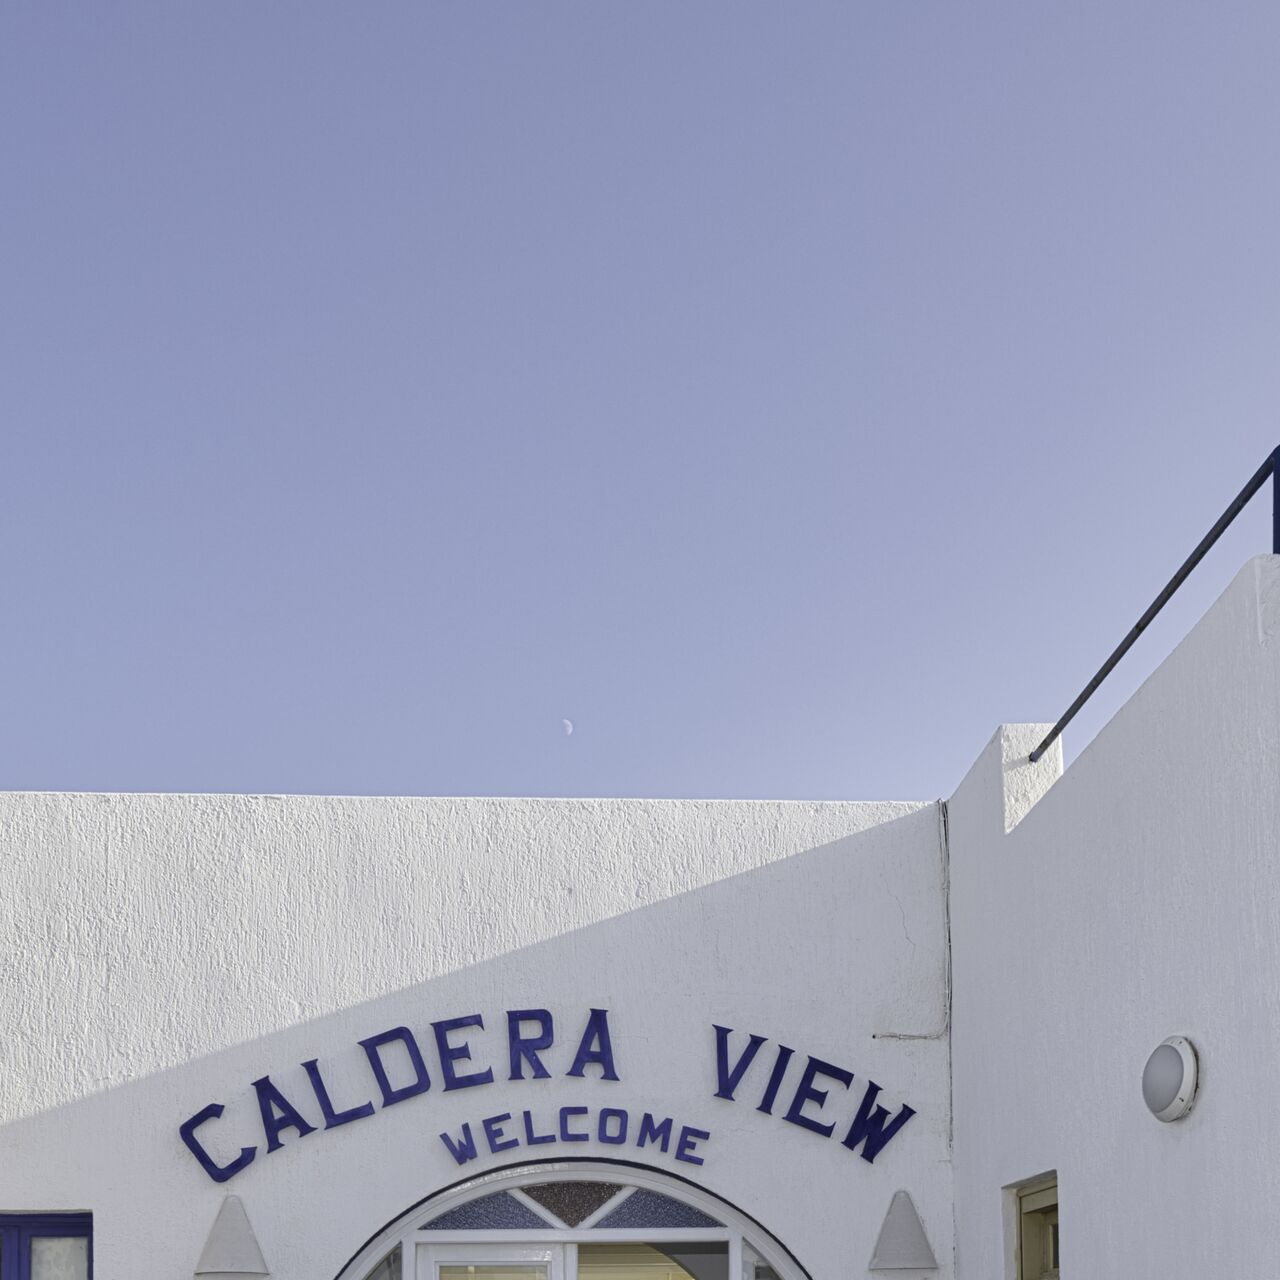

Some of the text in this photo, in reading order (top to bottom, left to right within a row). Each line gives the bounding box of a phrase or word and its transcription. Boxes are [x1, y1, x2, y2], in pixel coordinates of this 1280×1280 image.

[179, 1008, 917, 1183] CALDERA VIEW
[439, 1106, 710, 1167] WELCOME
